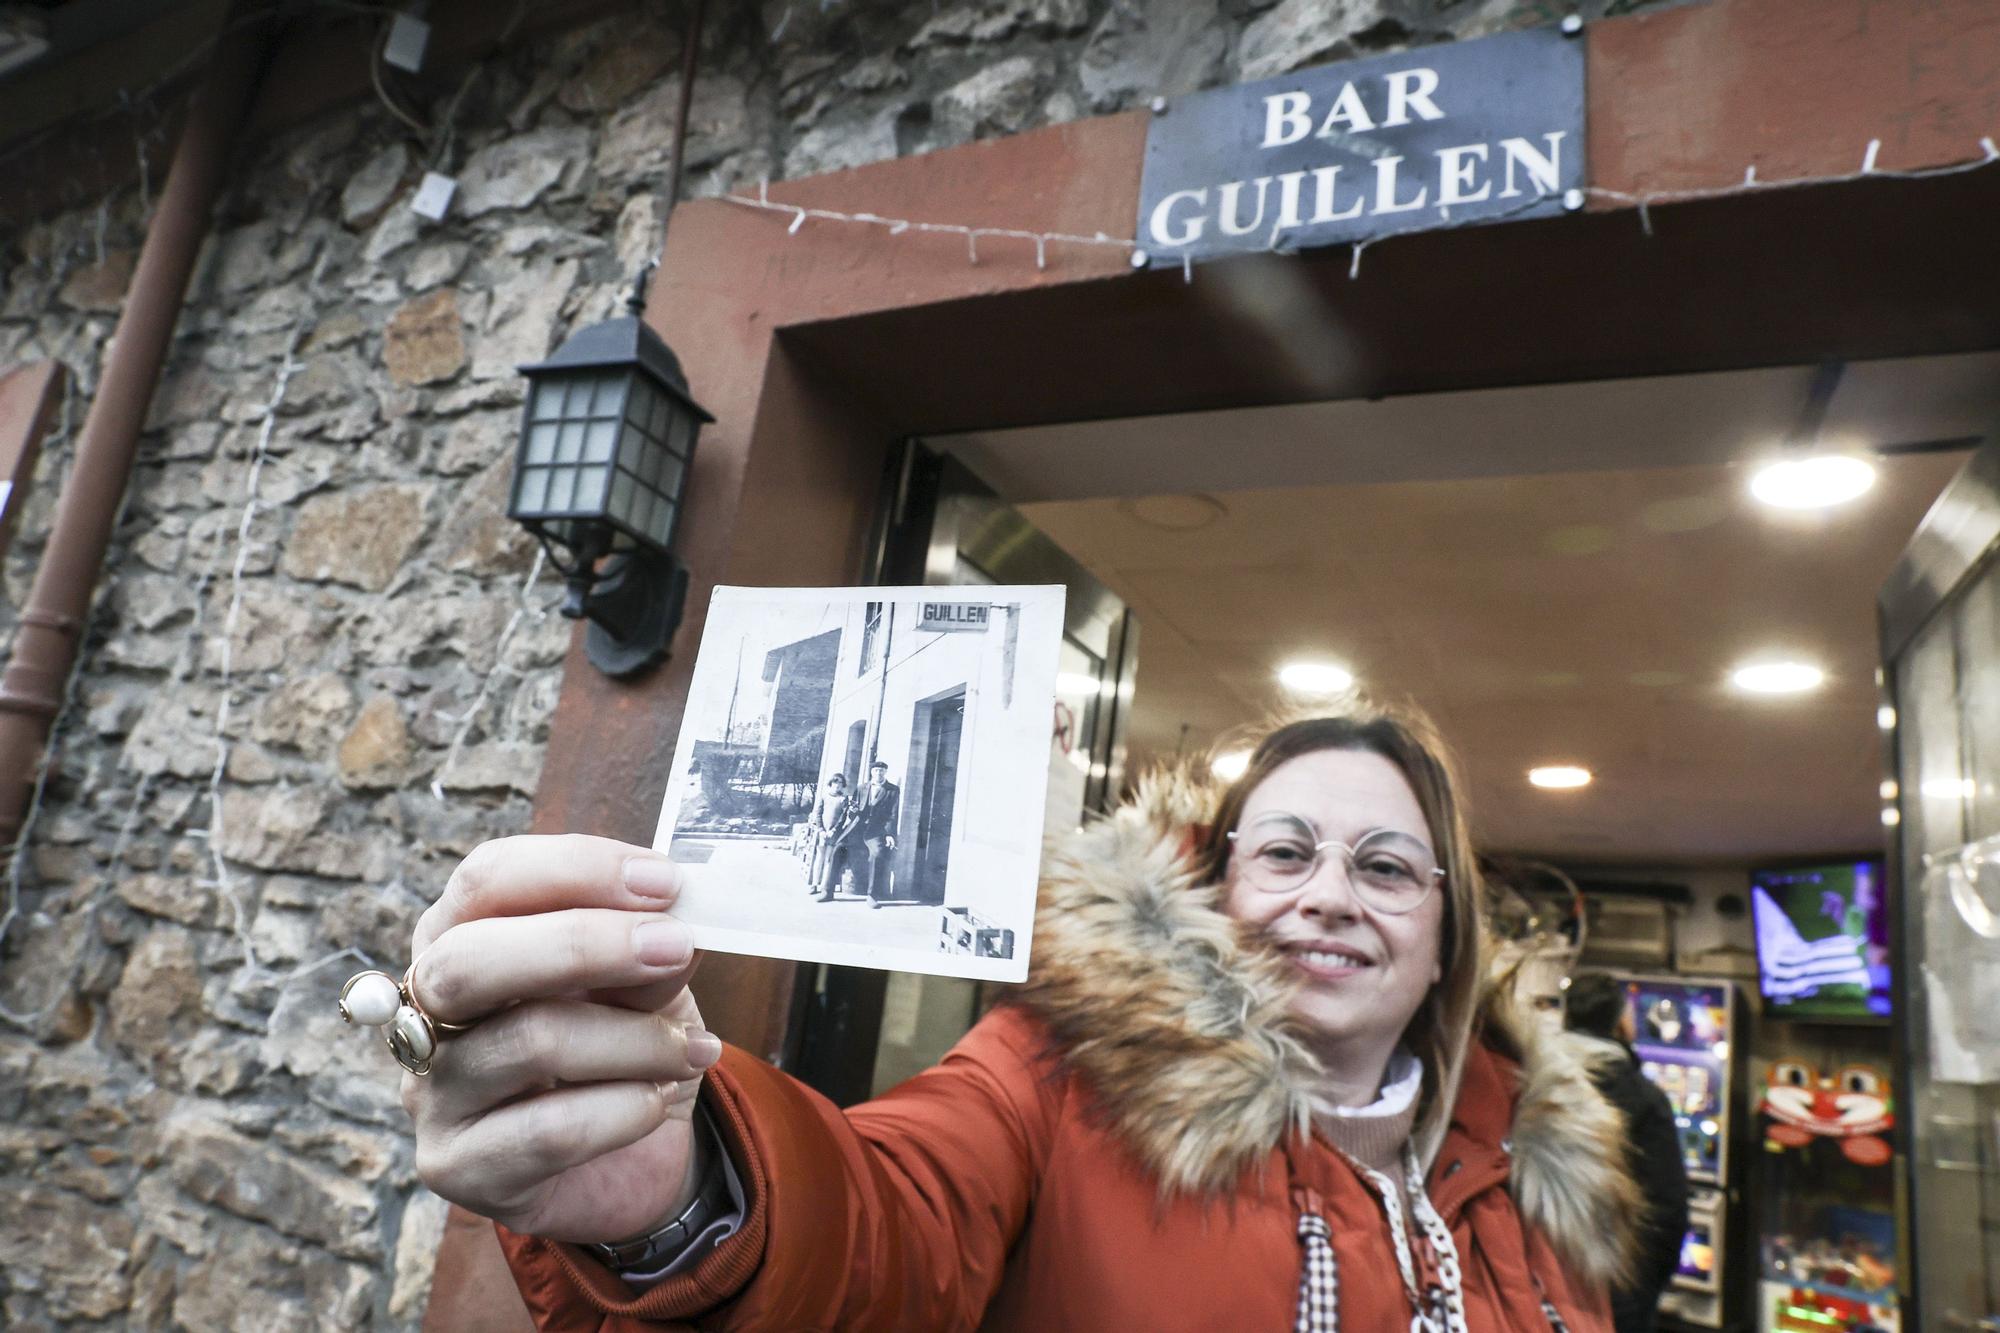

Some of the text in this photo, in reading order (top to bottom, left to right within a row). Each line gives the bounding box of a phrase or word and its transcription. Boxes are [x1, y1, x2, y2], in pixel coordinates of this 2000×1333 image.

[1259, 67, 1445, 149] BAR
[1150, 131, 1567, 246] GUILLEN
[923, 604, 988, 623] GUILLEN
